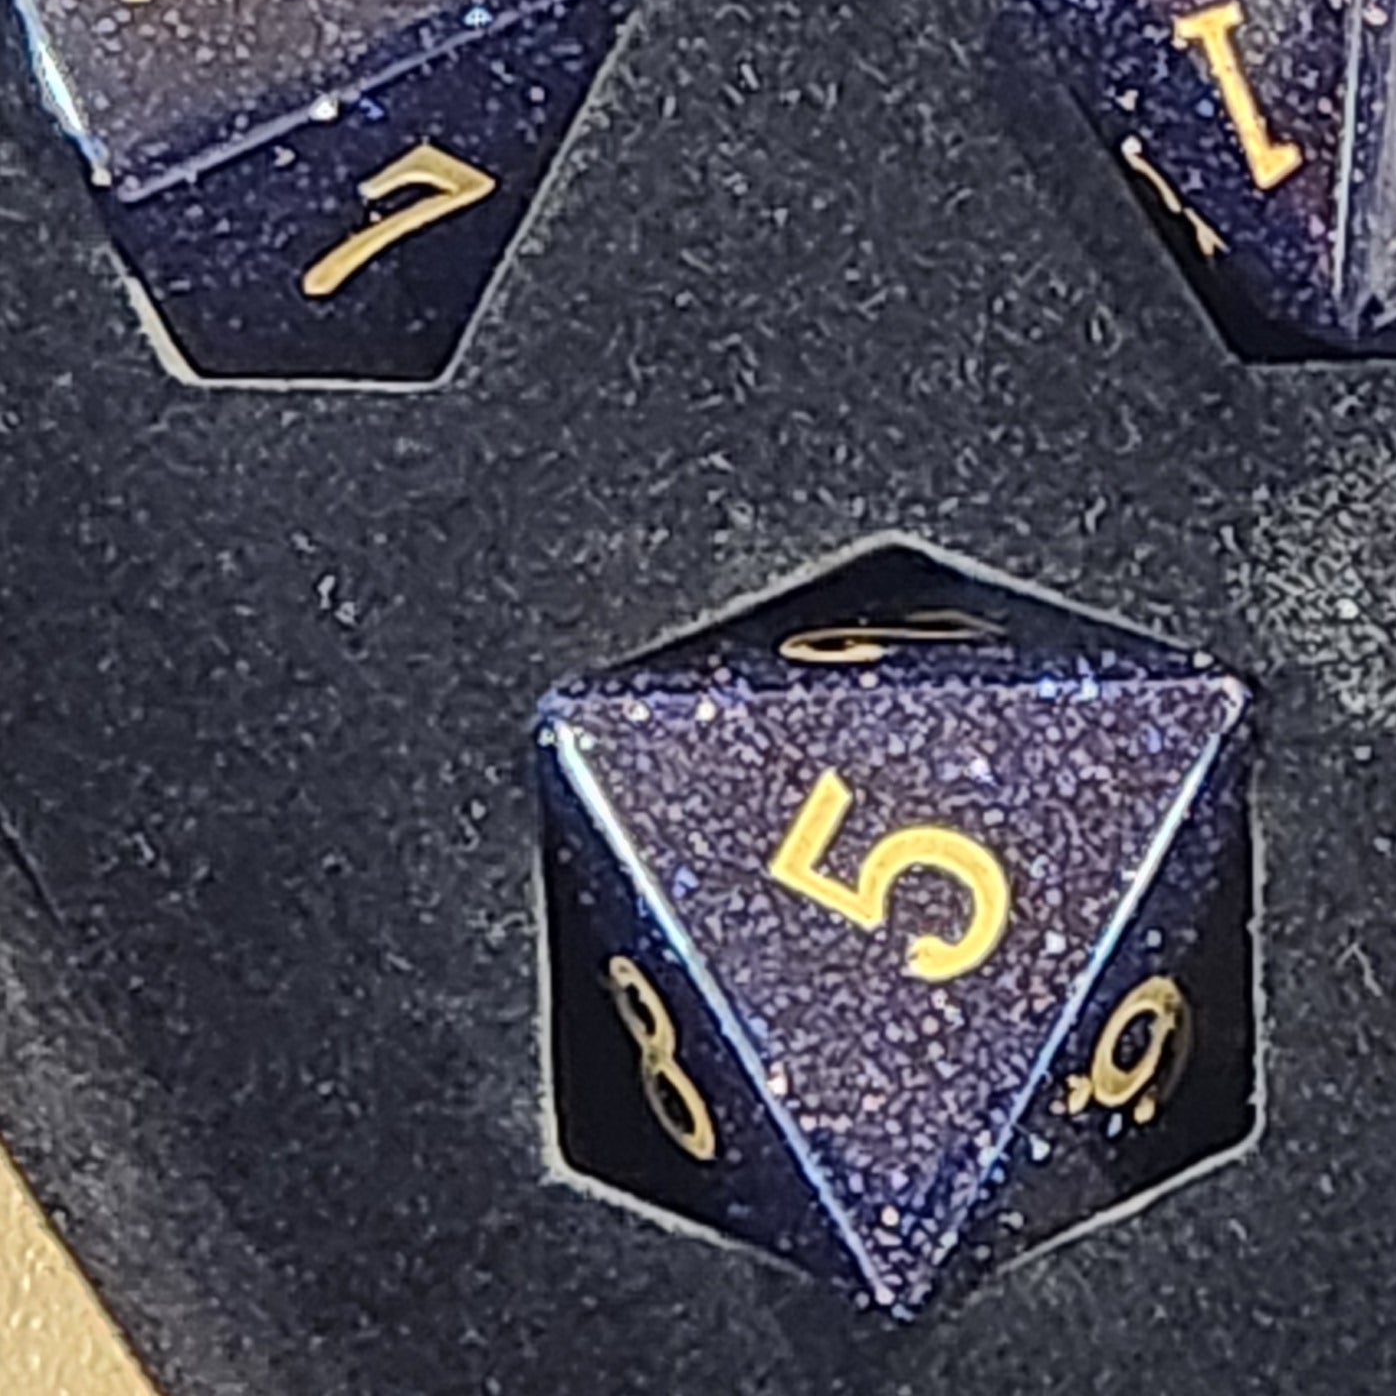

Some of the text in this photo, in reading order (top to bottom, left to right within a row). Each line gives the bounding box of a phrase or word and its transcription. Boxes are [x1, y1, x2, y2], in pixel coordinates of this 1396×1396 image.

[1172, 2, 1302, 190] 1
[301, 143, 497, 298] 7
[767, 767, 1011, 982] 5
[608, 955, 716, 1160] 8
